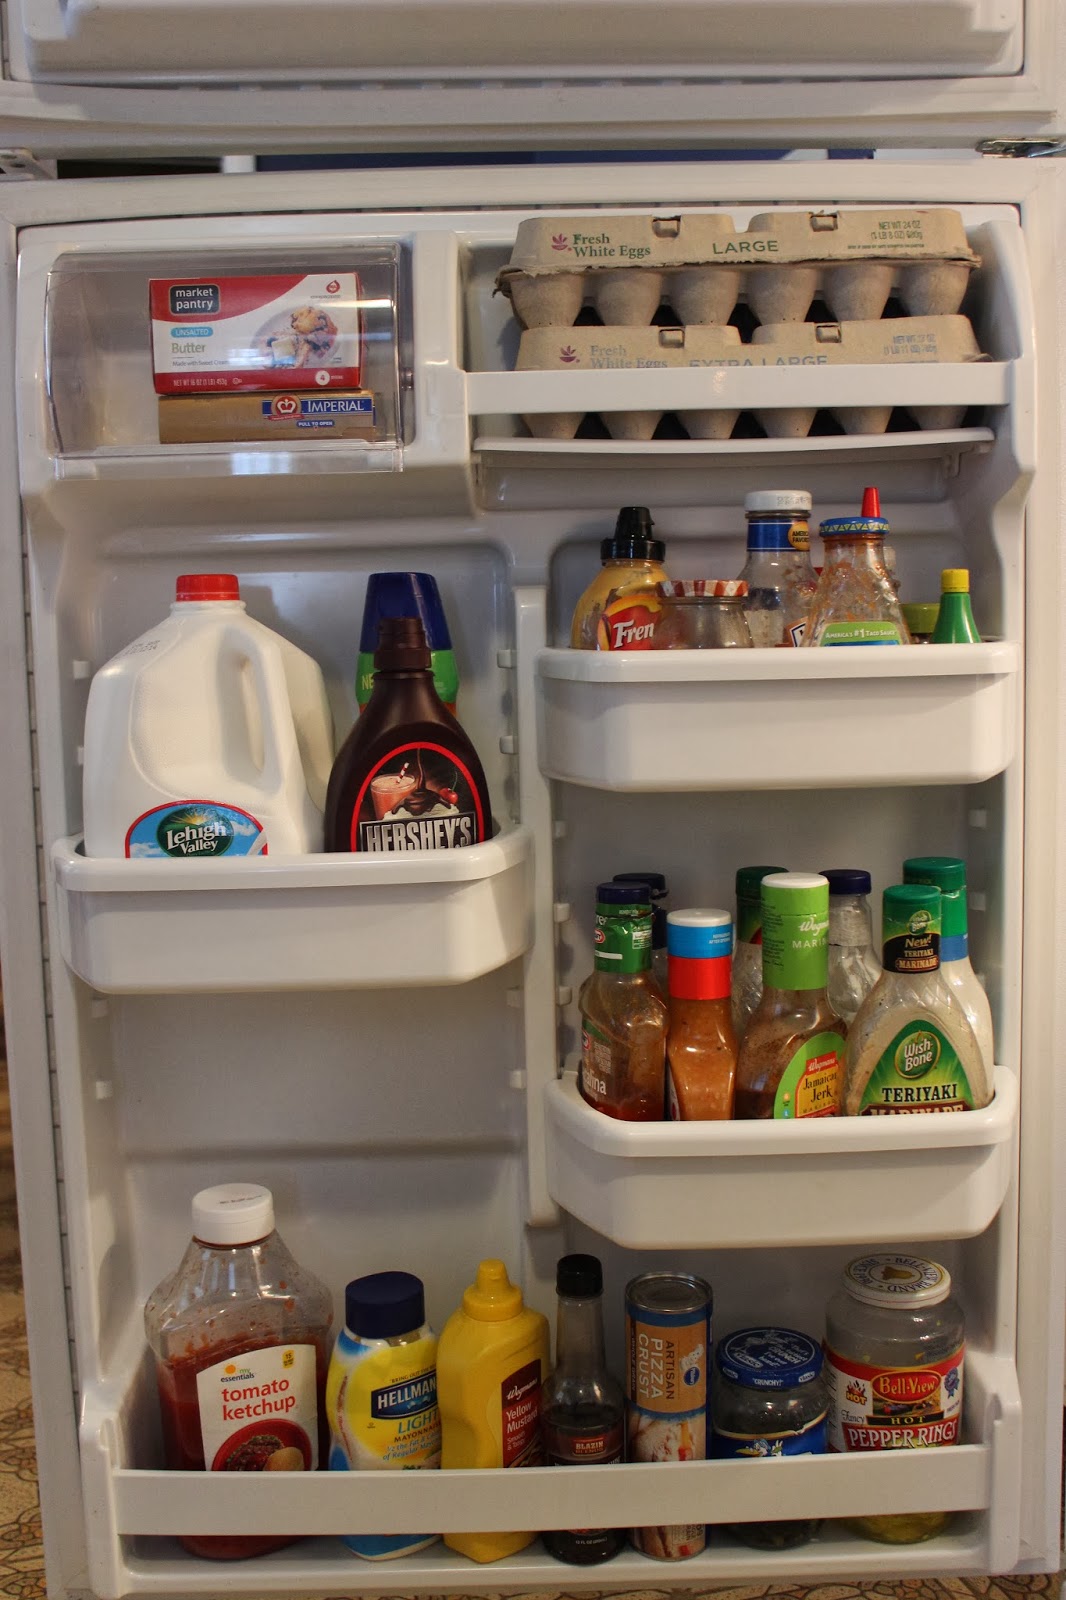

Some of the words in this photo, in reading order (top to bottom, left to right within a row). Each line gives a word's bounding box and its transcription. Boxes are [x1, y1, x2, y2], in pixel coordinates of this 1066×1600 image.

[573, 233, 610, 245] Fresh
[573, 245, 616, 258] White
[619, 246, 651, 260] Eggs
[712, 240, 779, 255] LARGE
[175, 287, 213, 298] market
[176, 299, 213, 311] pantry
[175, 328, 209, 336] UNSALTED
[171, 342, 206, 354] Butter
[590, 345, 627, 356] Fresh
[590, 357, 632, 369] White
[307, 399, 365, 413] IMPERIAL
[853, 628, 865, 638] #1
[166, 821, 228, 850] Lehigh
[366, 816, 472, 852] HERSHEY'S
[179, 839, 219, 855] Valley
[903, 948, 934, 958] TERIYAKI
[904, 1051, 933, 1072] Bone
[810, 1085, 833, 1103] Jerk
[881, 1083, 958, 1102] TERIYAKI
[638, 1333, 650, 1398] CRUST
[650, 1338, 664, 1399] PIZZA
[665, 1340, 675, 1400] ARTISAN
[220, 1372, 255, 1382] essentials
[221, 1379, 290, 1402] tomato
[845, 1391, 868, 1406] HOT
[222, 1395, 296, 1421] ketchup
[505, 1401, 532, 1421] Yellow
[506, 1406, 538, 1434] Mustard
[890, 1416, 925, 1425] HOT
[847, 1427, 915, 1449] PEPPER
[917, 1419, 958, 1447] RINGS
